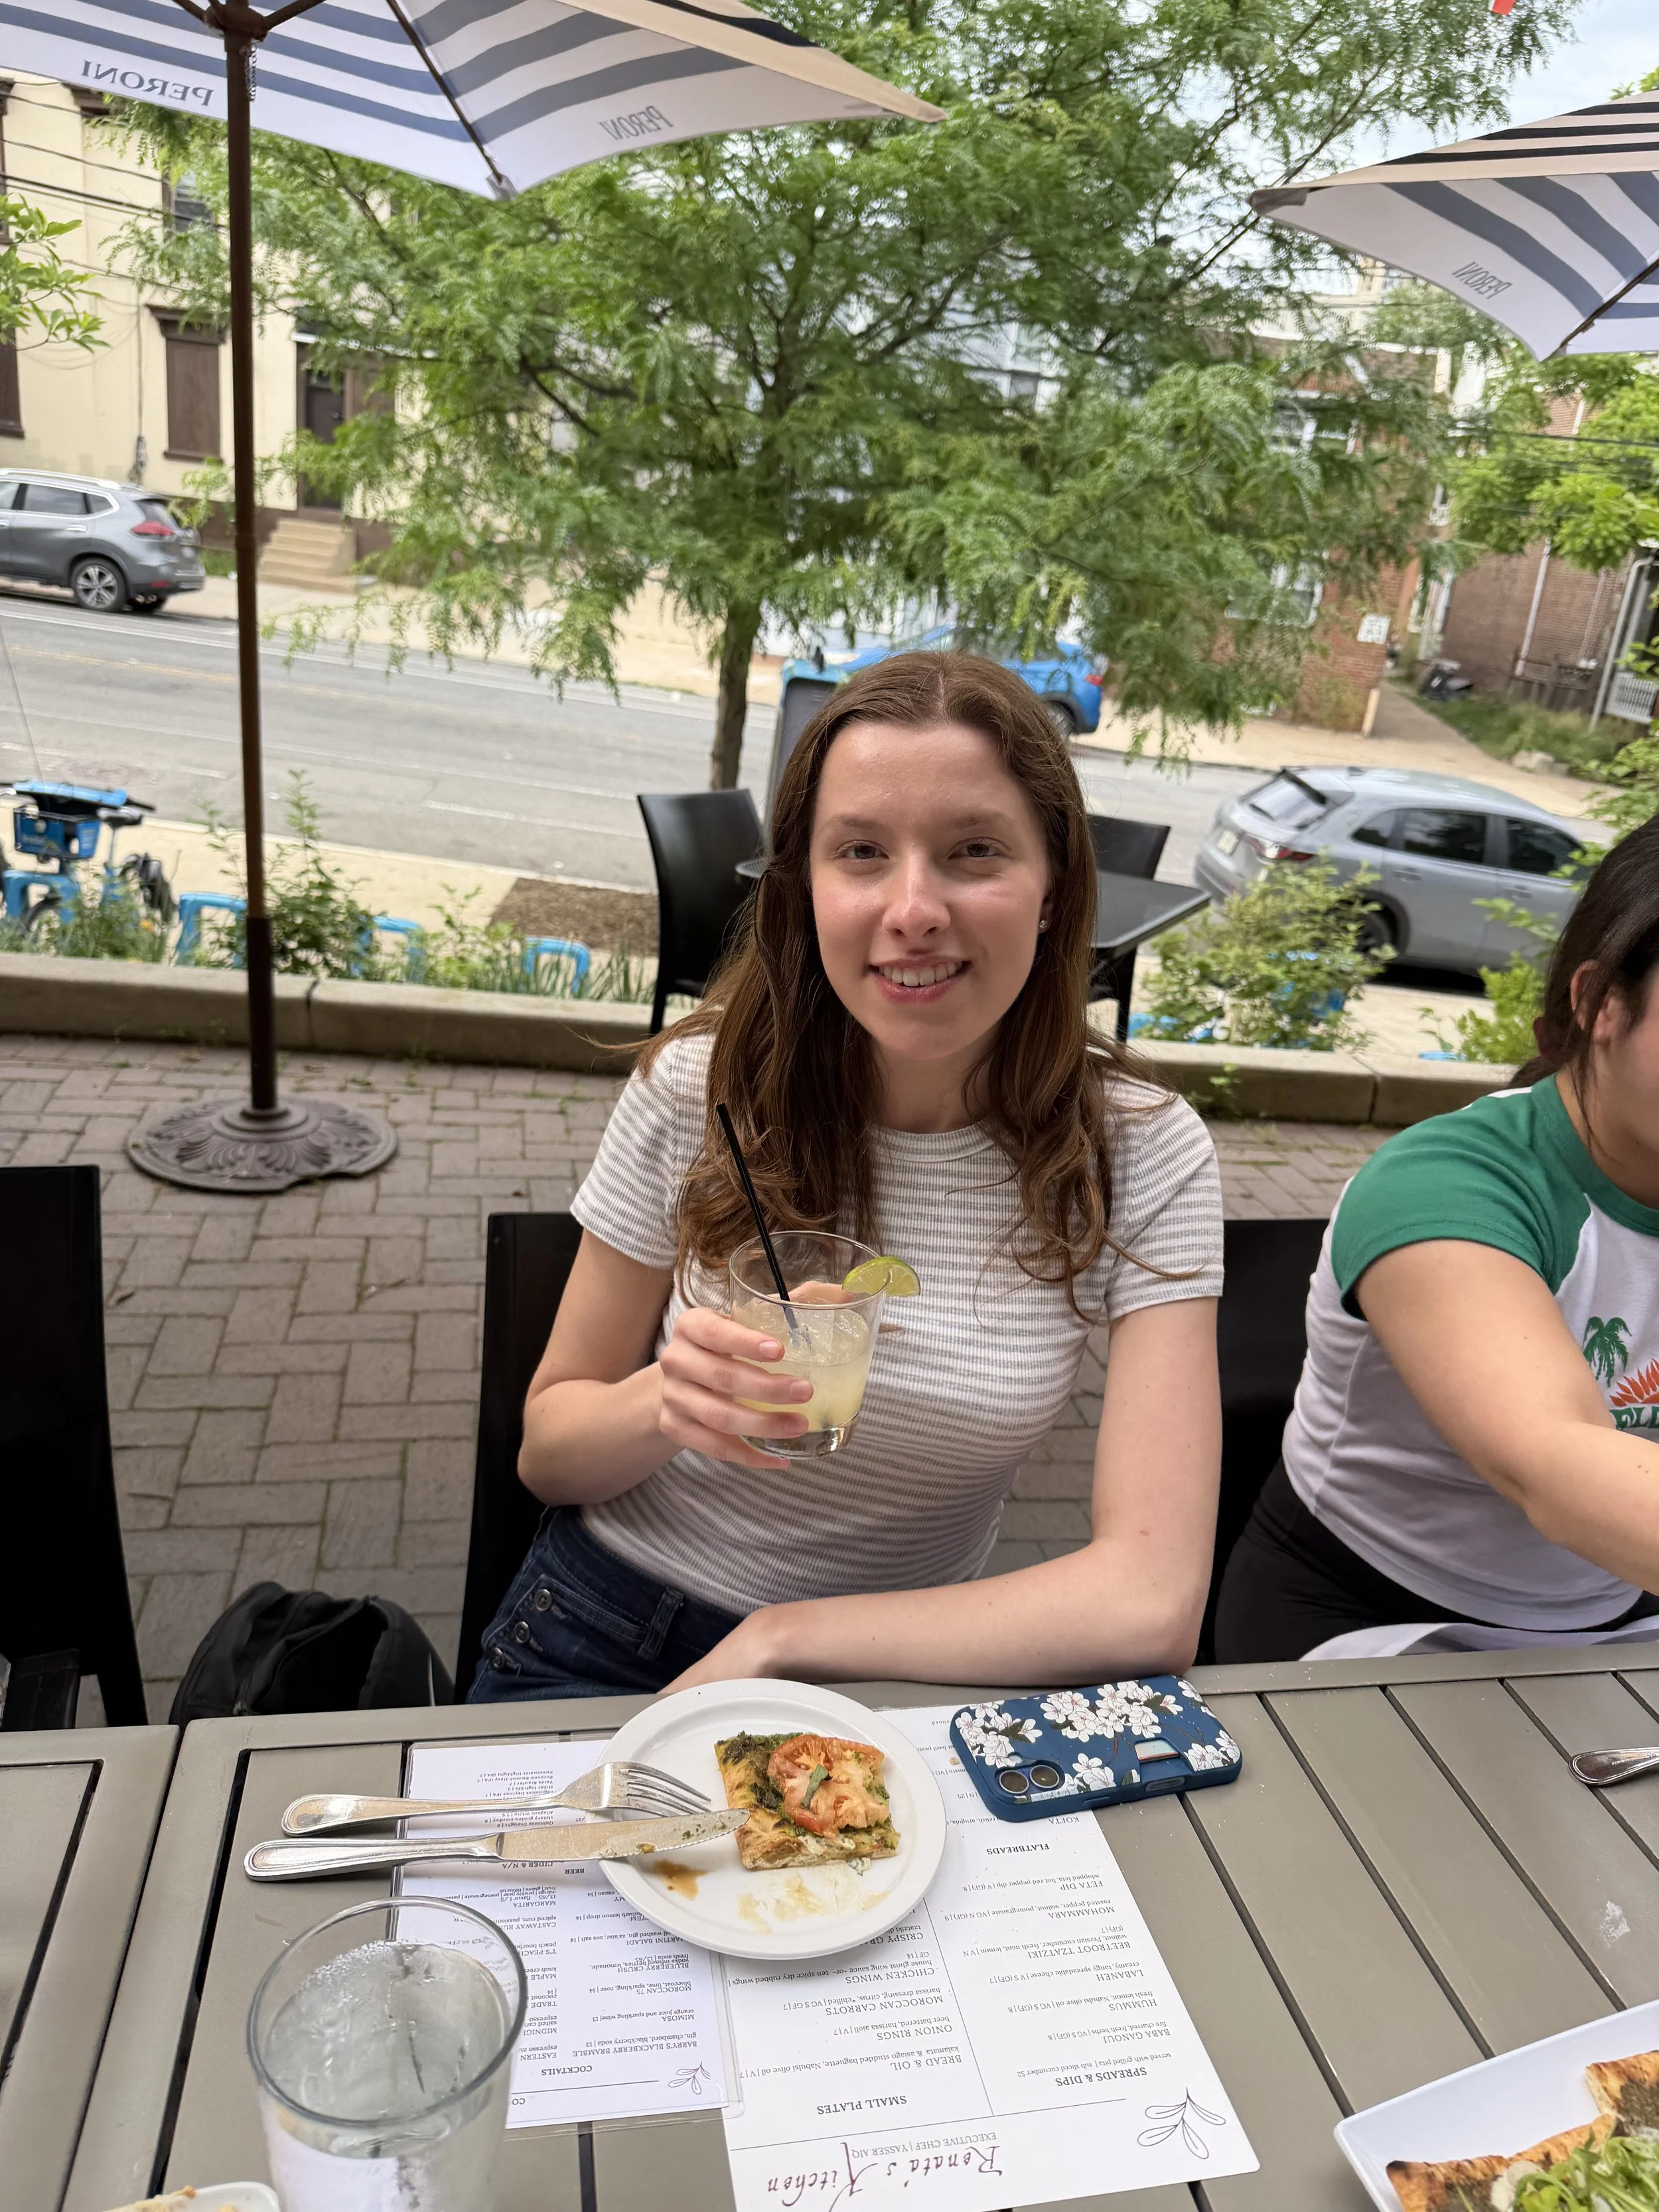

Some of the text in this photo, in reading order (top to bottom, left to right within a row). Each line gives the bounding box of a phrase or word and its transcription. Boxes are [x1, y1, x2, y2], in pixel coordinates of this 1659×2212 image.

[986, 1844, 1049, 1855] FLATBREADS
[991, 1905, 1035, 1915] pomegranate
[1048, 1907, 1115, 1919] MOHAMMARA
[888, 1932, 924, 1943] CRISPY
[1027, 1941, 1131, 1958] BEETROOT TZATZIKI
[646, 1962, 689, 1971] BLUEBERRY
[889, 1960, 909, 1969] ghost
[845, 1968, 934, 1984] CHICKEN WINGS
[1055, 1966, 1092, 1976] spreadable
[1096, 1969, 1143, 1982] LABANEH
[755, 1975, 781, 1984] rubbed
[646, 1985, 691, 1994] MOROCCAN
[881, 1990, 914, 1999] dressing,
[1083, 1996, 1110, 2004] Nabulsi
[1108, 1999, 1157, 2011] HUMMUS
[826, 1996, 943, 2016] MOROCCAN CARROTS
[898, 2018, 932, 2028] battered,
[1127, 2022, 1155, 2031] charred,
[877, 2024, 952, 2041] ONION RINGS
[1103, 2028, 1171, 2043] BABA GANOUJ
[573, 2041, 697, 2057] BARRY'S BLACKBERRY BRAMBLE
[926, 2046, 960, 2055] kalamata
[520, 2052, 557, 2061] EASTERN
[822, 2057, 859, 2067] baguette,
[859, 2054, 890, 2065] studded
[1112, 2056, 1133, 2066] grilled
[792, 2063, 821, 2072] Nabulsi
[890, 2055, 962, 2071] BREAD & OIL
[1060, 2064, 1080, 2073] sliced
[541, 2065, 593, 2076] COCKTAILS
[1027, 2067, 1060, 2075] cucumber
[1055, 2067, 1147, 2087] SPREADS & DIPS
[817, 2095, 907, 2114] SMALL PLATES
[942, 2132, 997, 2146] EXECUTIVE
[871, 2144, 908, 2156] YASSER
[915, 2140, 941, 2150] CHEF
[766, 2142, 878, 2212] Kitchen
